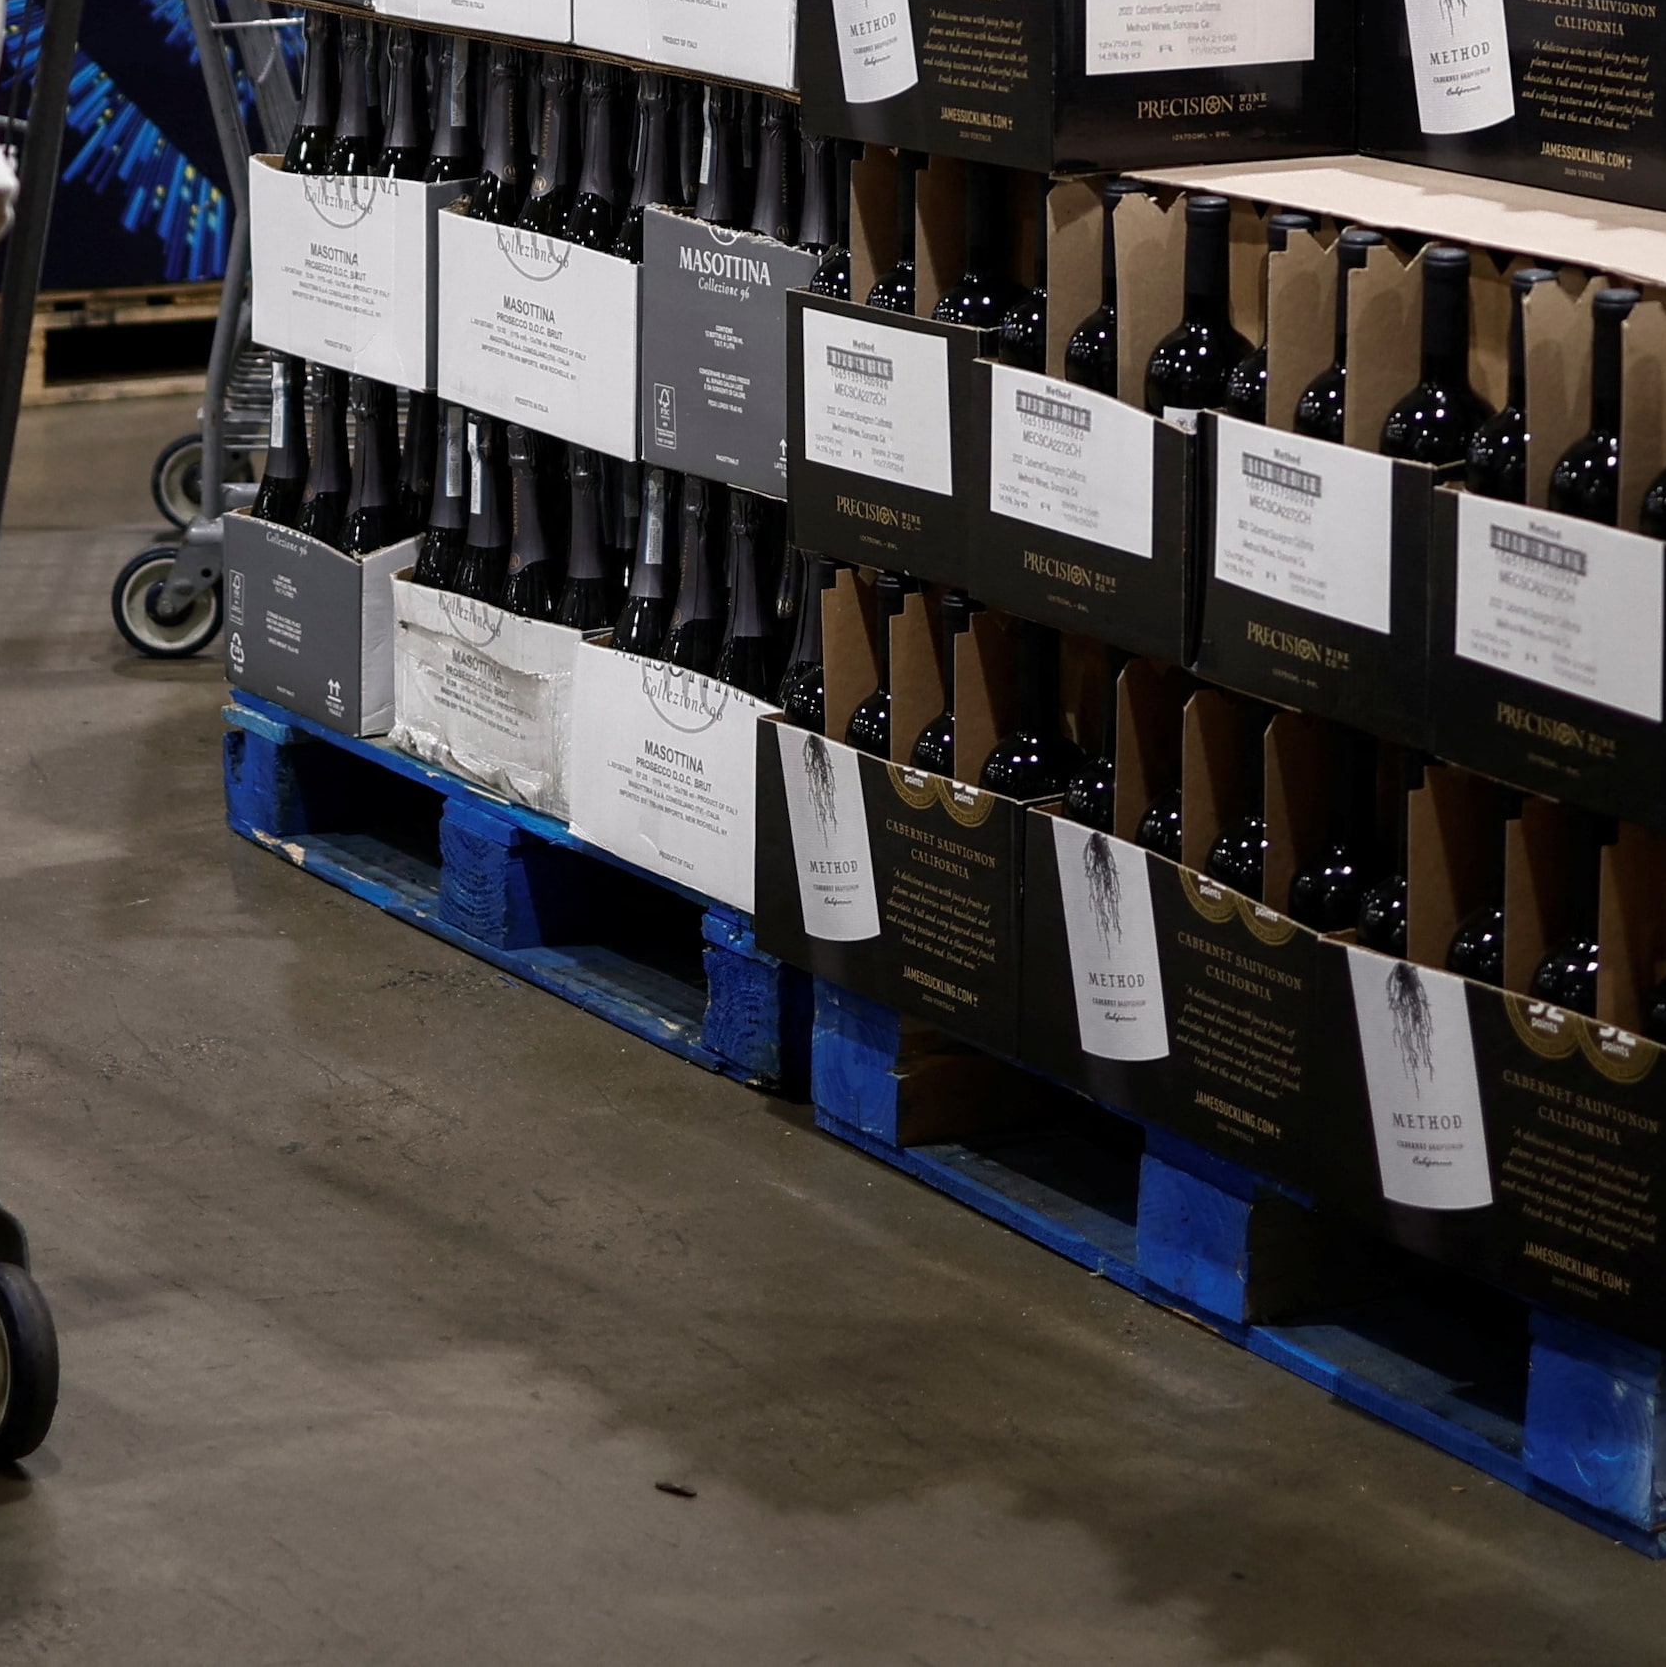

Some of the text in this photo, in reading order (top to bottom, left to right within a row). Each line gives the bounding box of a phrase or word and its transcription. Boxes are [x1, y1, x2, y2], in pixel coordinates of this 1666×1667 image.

[849, 11, 897, 38] METHOD
[1555, 15, 1624, 35] CALIFORNIA
[1429, 41, 1491, 66] METHOD
[1137, 93, 1267, 119] PRECISION WINE
[1540, 141, 1625, 169] JAMESSUCKLING.COM
[678, 245, 771, 287] MASOTTINA
[503, 295, 556, 324] MASOTTINA
[835, 494, 899, 528] PRECISION
[1023, 549, 1092, 589] PRECISION
[451, 649, 503, 683] MASOTTINA
[641, 675, 709, 717] Collezione
[644, 739, 705, 775] MASOTTINA
[885, 818, 997, 869] CABERNET SAUVIGNON
[809, 859, 859, 875] METHOD
[1392, 1112, 1463, 1131] METHOD
